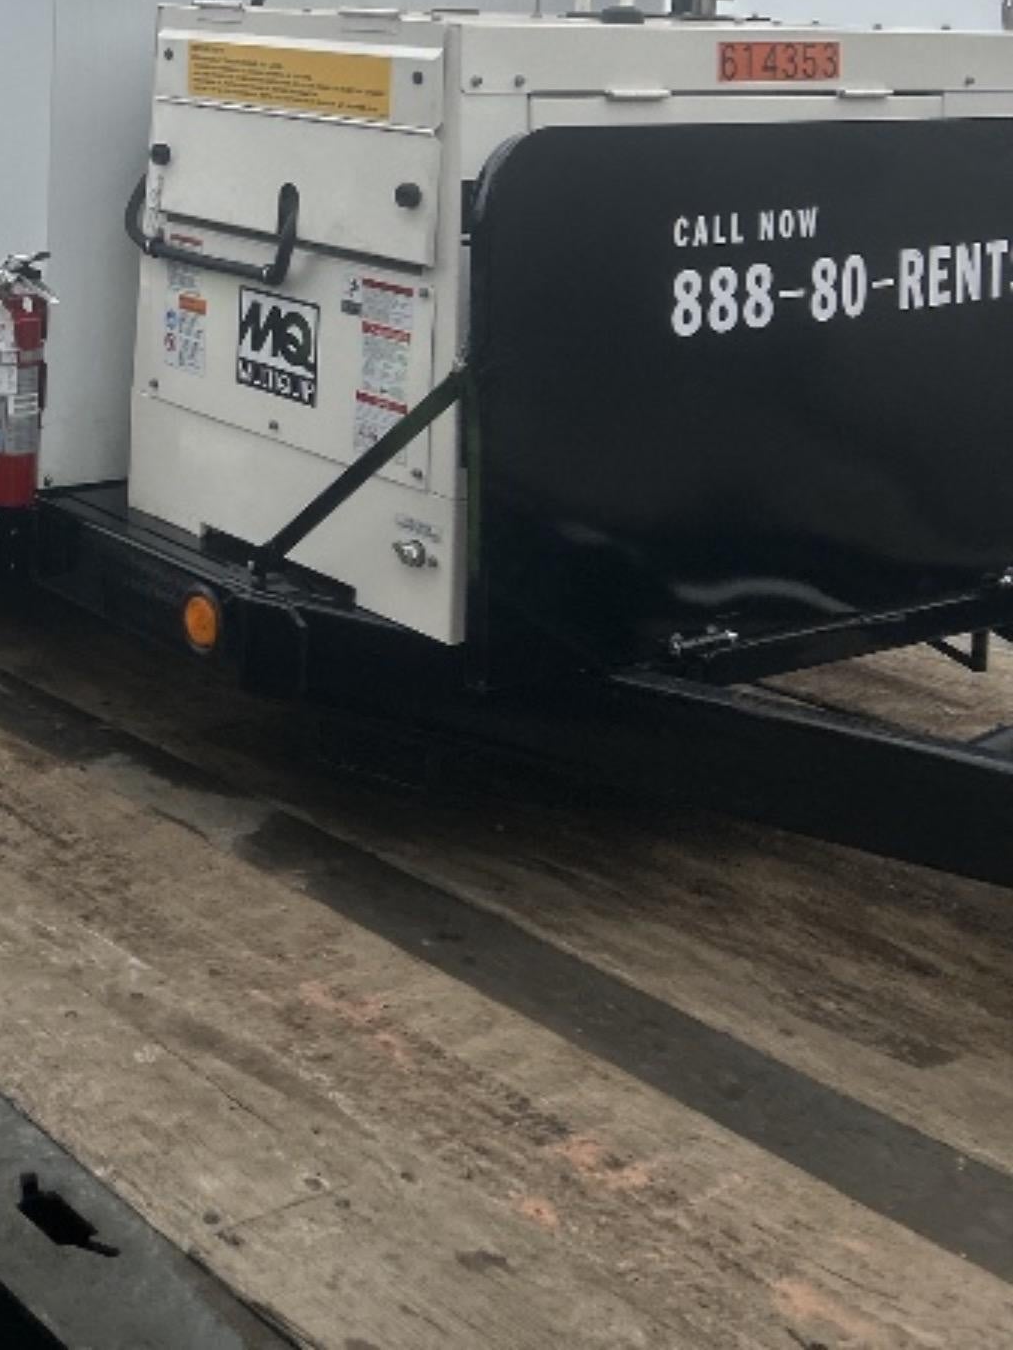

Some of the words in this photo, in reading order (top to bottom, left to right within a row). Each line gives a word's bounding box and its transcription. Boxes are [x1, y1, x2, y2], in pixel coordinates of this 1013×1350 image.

[721, 42, 838, 81] 614353
[674, 213, 744, 246] CALL
[760, 207, 817, 240] NOW
[671, 239, 1013, 336] 888-80-RENT
[239, 300, 316, 372] MQ
